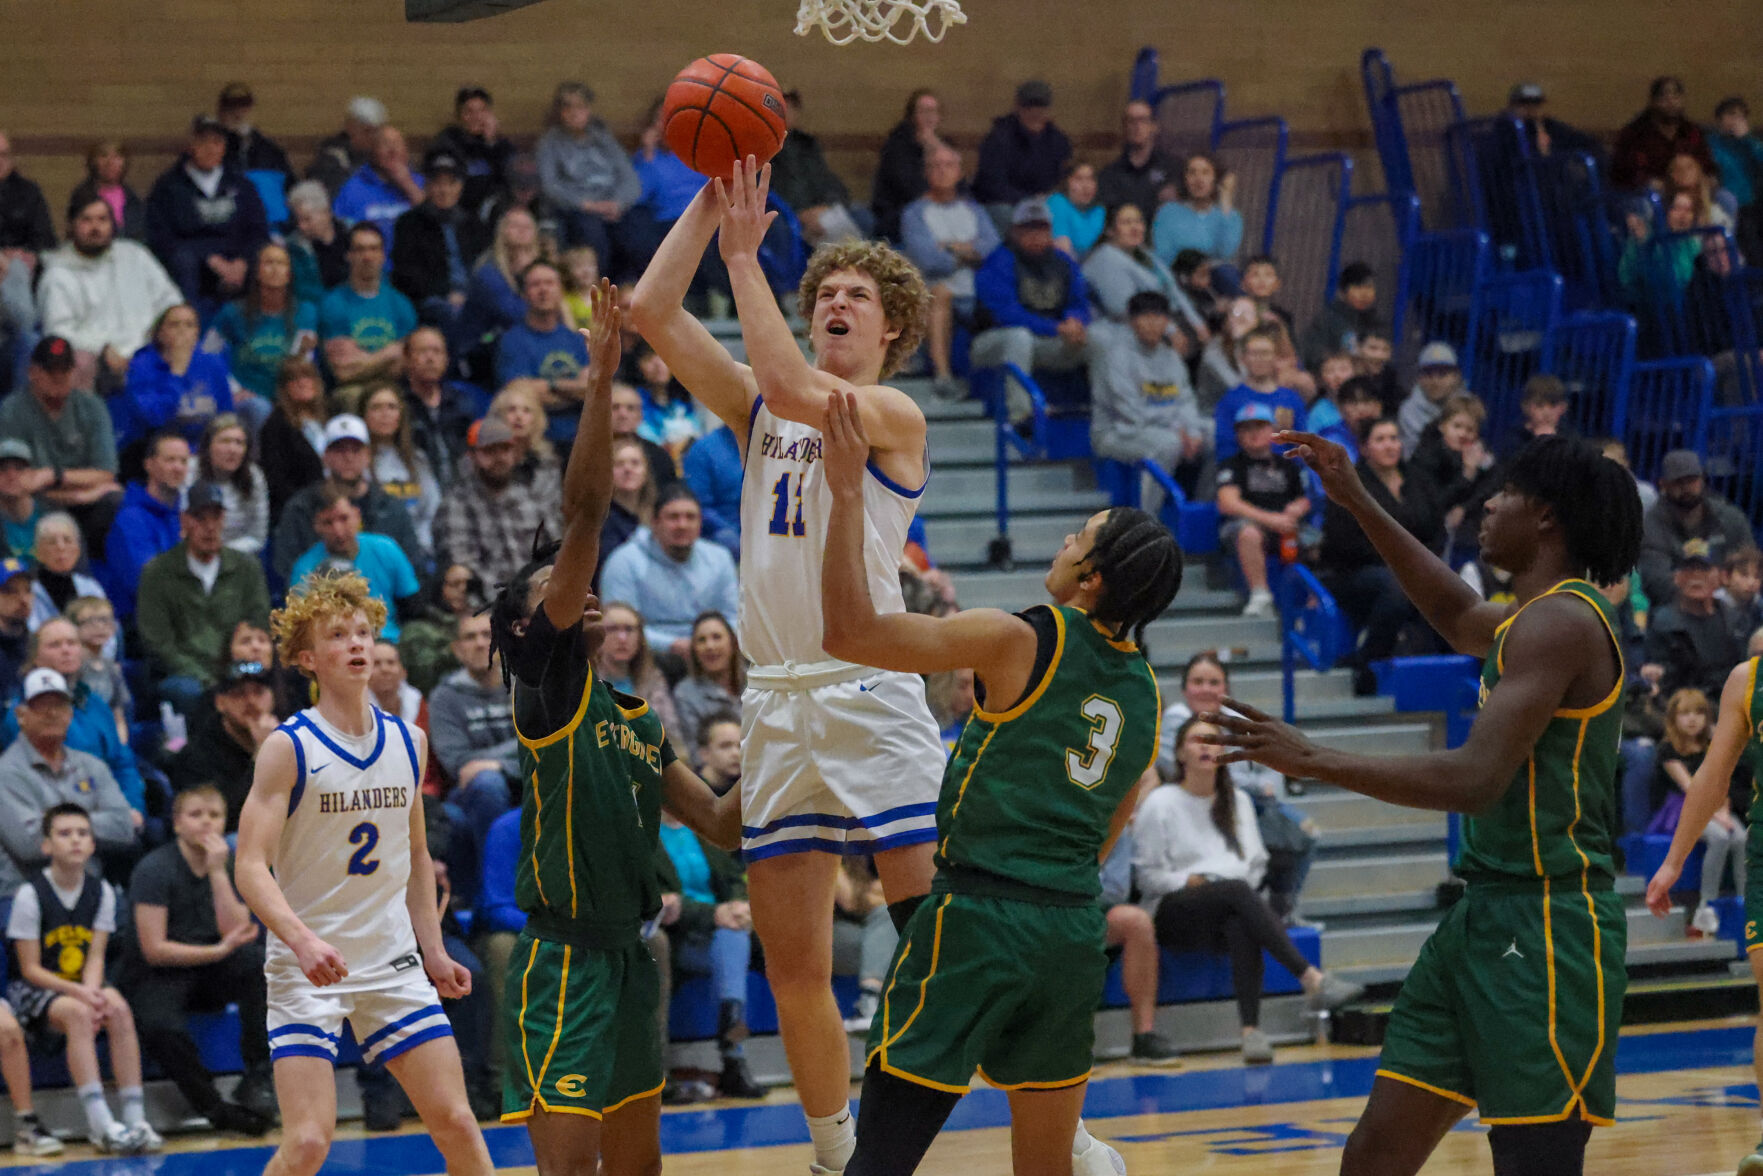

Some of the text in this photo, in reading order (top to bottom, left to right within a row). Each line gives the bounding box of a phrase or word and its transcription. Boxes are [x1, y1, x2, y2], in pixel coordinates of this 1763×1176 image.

[768, 471, 807, 538] 11
[1064, 692, 1126, 791] 3
[319, 786, 407, 814] HILANDERS
[346, 820, 380, 877] 2
